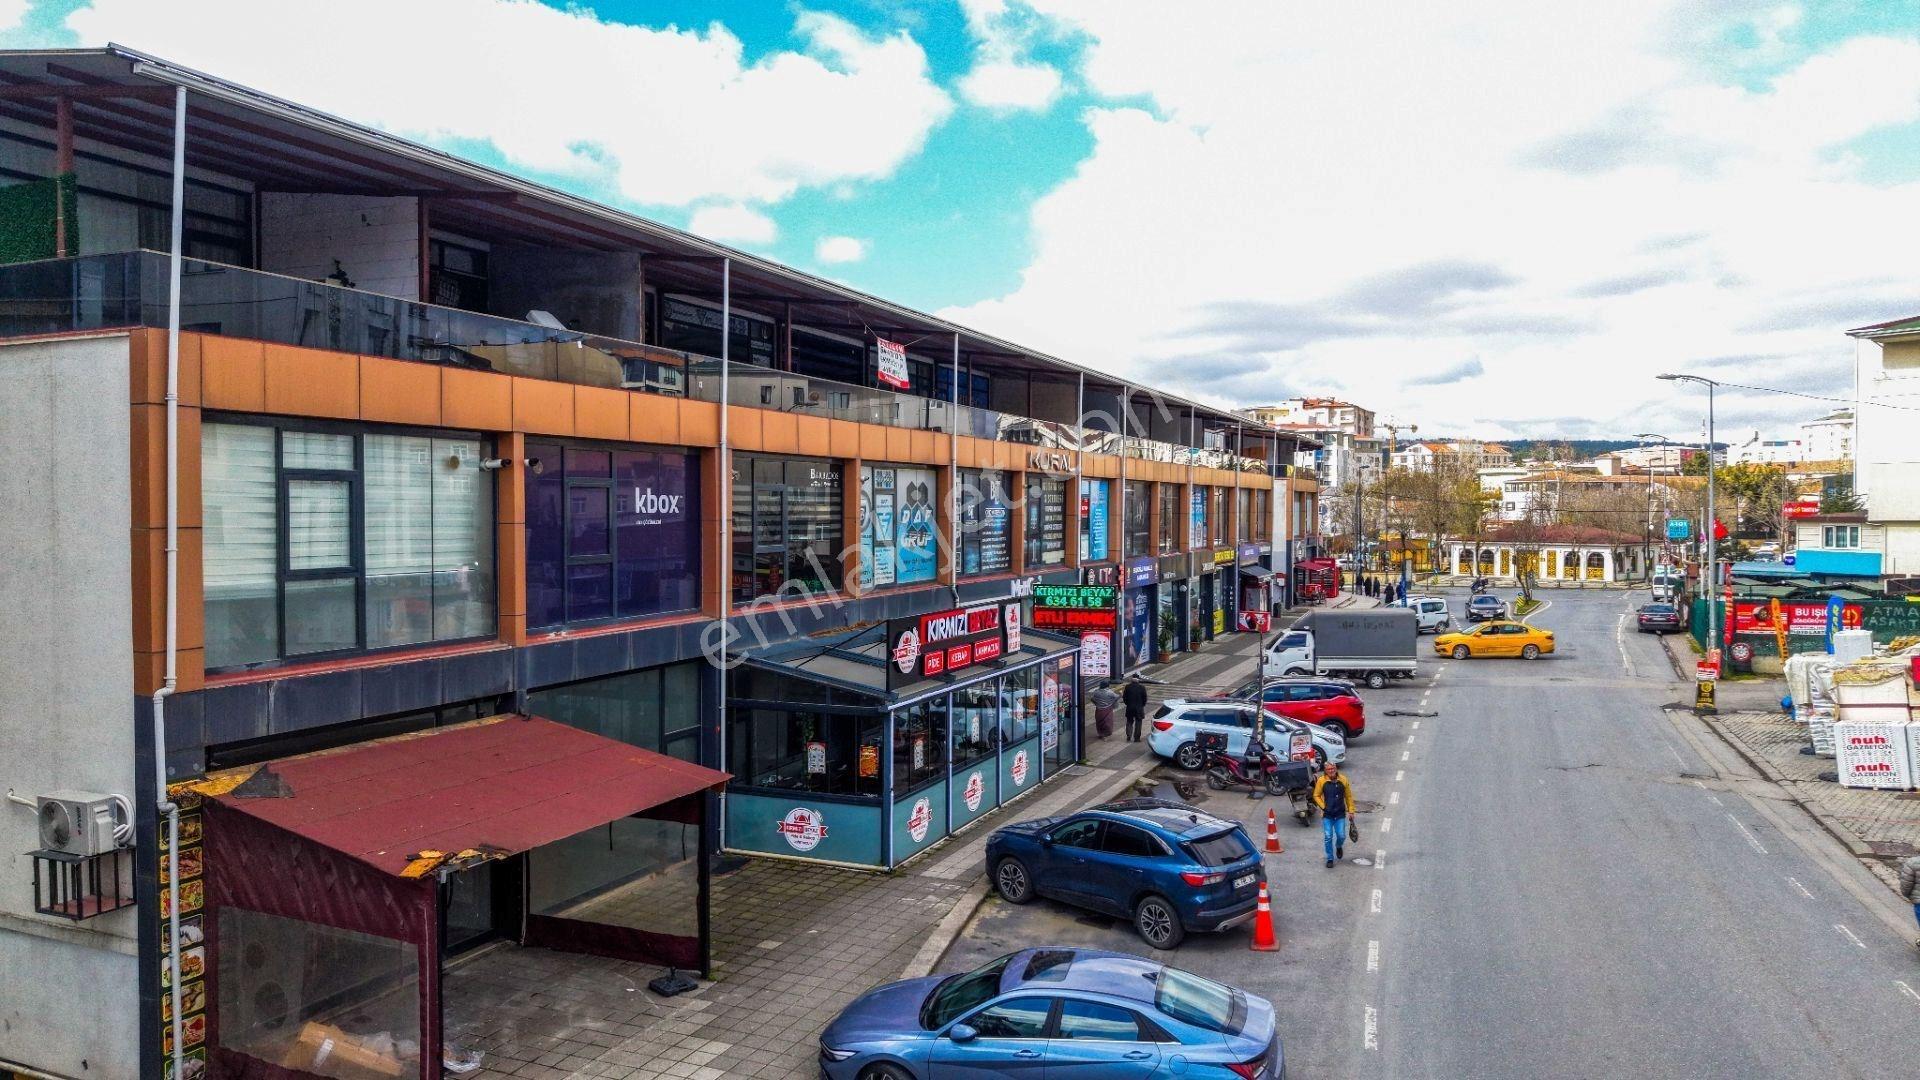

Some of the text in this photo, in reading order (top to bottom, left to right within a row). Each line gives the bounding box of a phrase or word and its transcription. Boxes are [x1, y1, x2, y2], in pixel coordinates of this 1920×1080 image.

[635, 487, 680, 514] kbox
[1036, 588, 1113, 597] KIRMIZI BEYAZ
[1046, 596, 1102, 607] 634 61 58
[1795, 607, 1809, 617] BU
[1872, 606, 1919, 617] ATMA
[927, 613, 968, 643] KIRMIZI
[927, 657, 941, 670] PİDE
[1851, 736, 1886, 745] nuh
[1854, 763, 1891, 772] nuh
